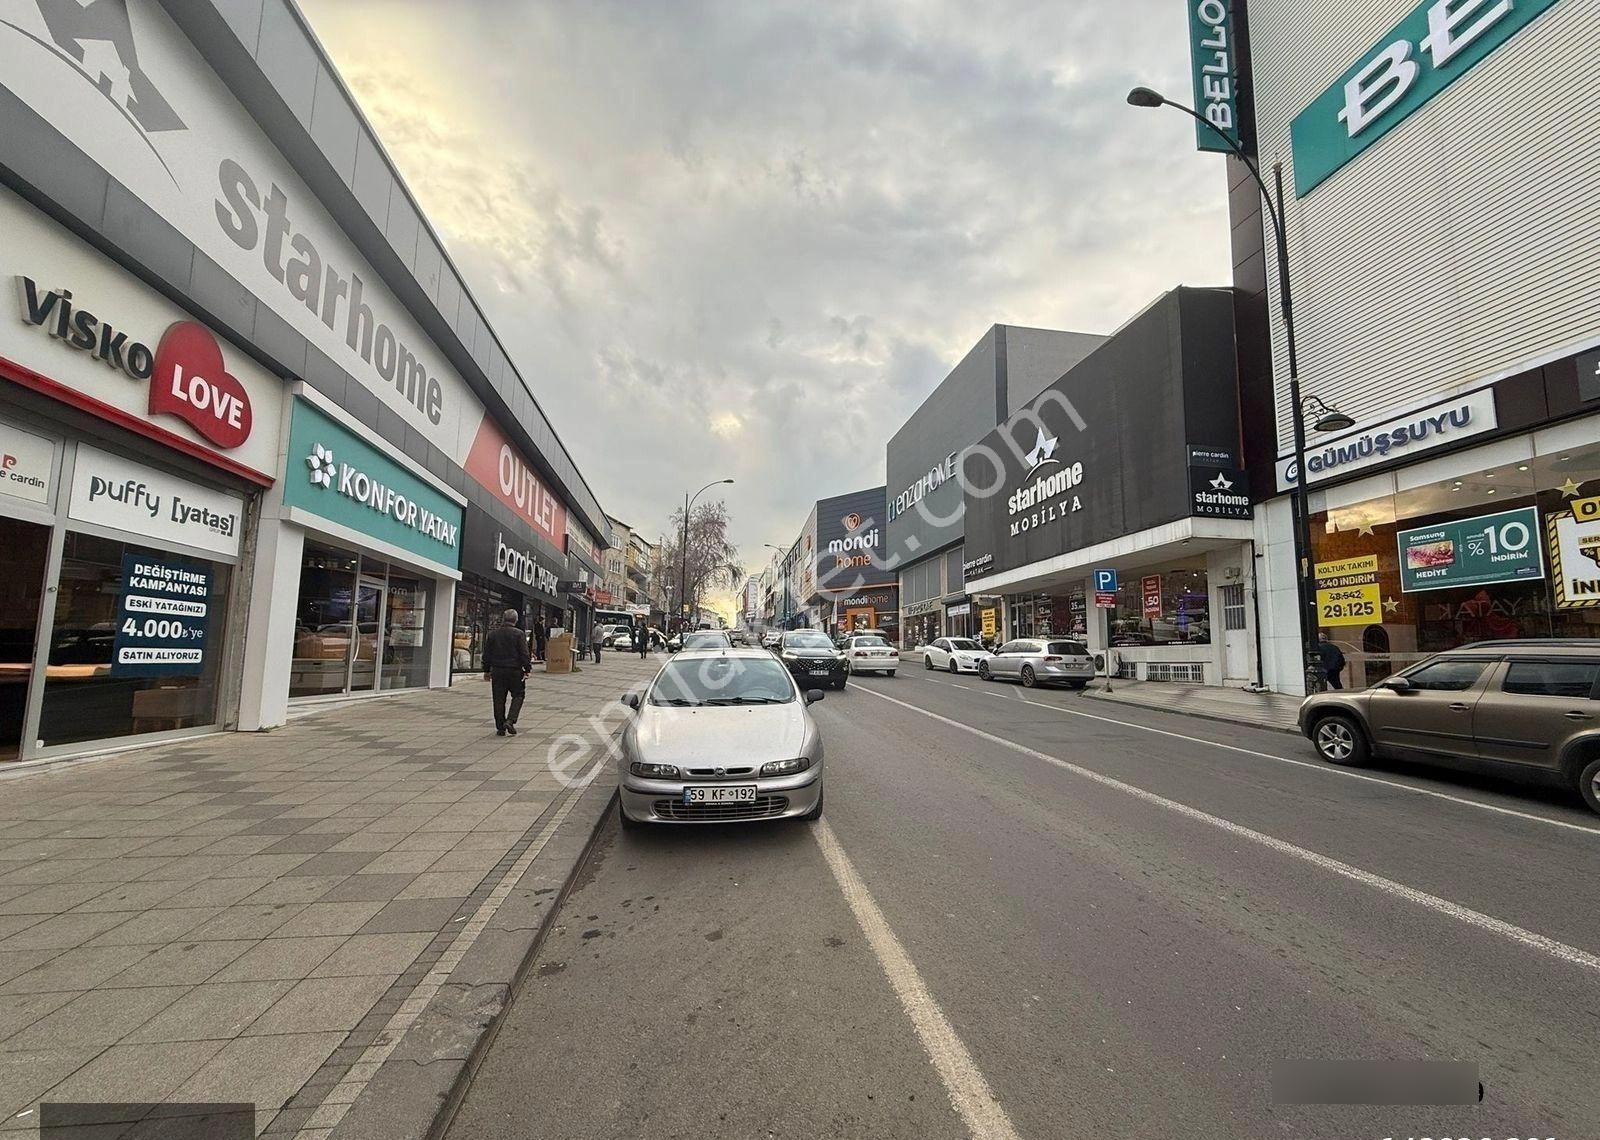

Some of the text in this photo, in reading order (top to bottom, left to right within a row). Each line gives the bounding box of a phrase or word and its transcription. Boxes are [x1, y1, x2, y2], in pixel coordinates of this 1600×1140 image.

[214, 158, 443, 426] starhome
[170, 363, 244, 431] LOVE
[1307, 405, 1471, 473] GÜMÜŞSUYU
[10, 472, 45, 489] cardin
[498, 443, 558, 536] OUTLET
[1007, 461, 1083, 516] starhome
[89, 475, 160, 518] puffy
[337, 462, 457, 547] KONFOR YATAK
[1195, 491, 1249, 506] starhome
[1010, 495, 1083, 537] MOBİLYA
[1196, 505, 1249, 515] MOBİLYA
[828, 529, 880, 554] mondi
[1409, 531, 1445, 542] Samsung
[496, 532, 559, 598] bambi YATAK
[835, 553, 873, 570] home
[1490, 550, 1529, 563] İNDİRİM
[134, 563, 206, 585] DEĞİŞTİRME
[1317, 560, 1374, 575] KOLTUK TAKIMI
[129, 576, 207, 597] KAMPANYASI
[1099, 572, 1112, 590] P
[1318, 578, 1339, 588] %40
[130, 598, 204, 614] ESKİ YATAĞINIZI
[123, 651, 199, 660] SATIN ALIYORUZ
[690, 789, 755, 800] 59 KF 192
